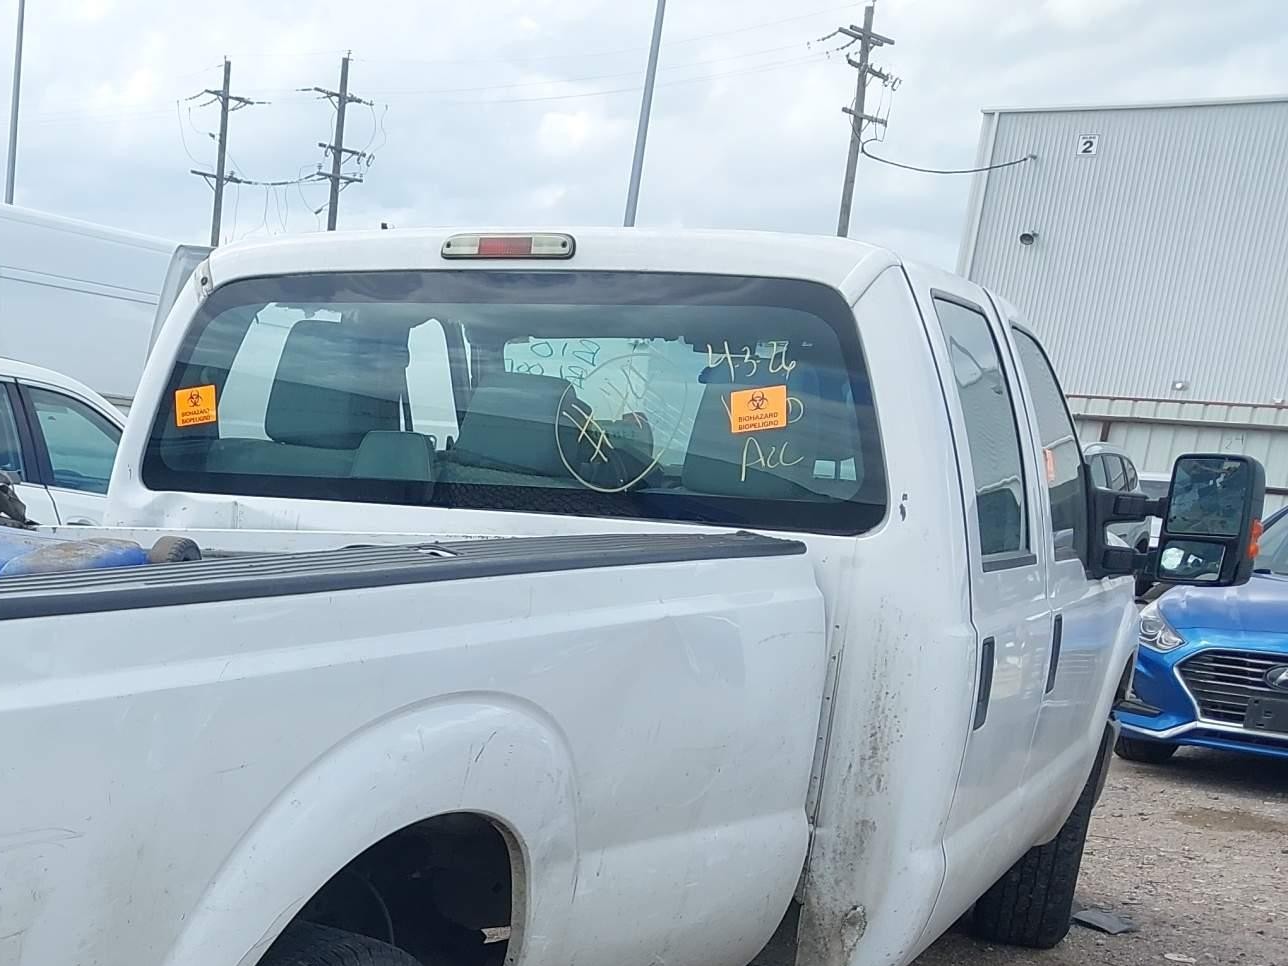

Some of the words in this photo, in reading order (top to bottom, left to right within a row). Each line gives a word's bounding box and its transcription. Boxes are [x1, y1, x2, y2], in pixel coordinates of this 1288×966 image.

[1082, 140, 1094, 153] 2
[738, 412, 778, 422] BIOHAZARD
[738, 420, 779, 430] BIOPELIGRO
